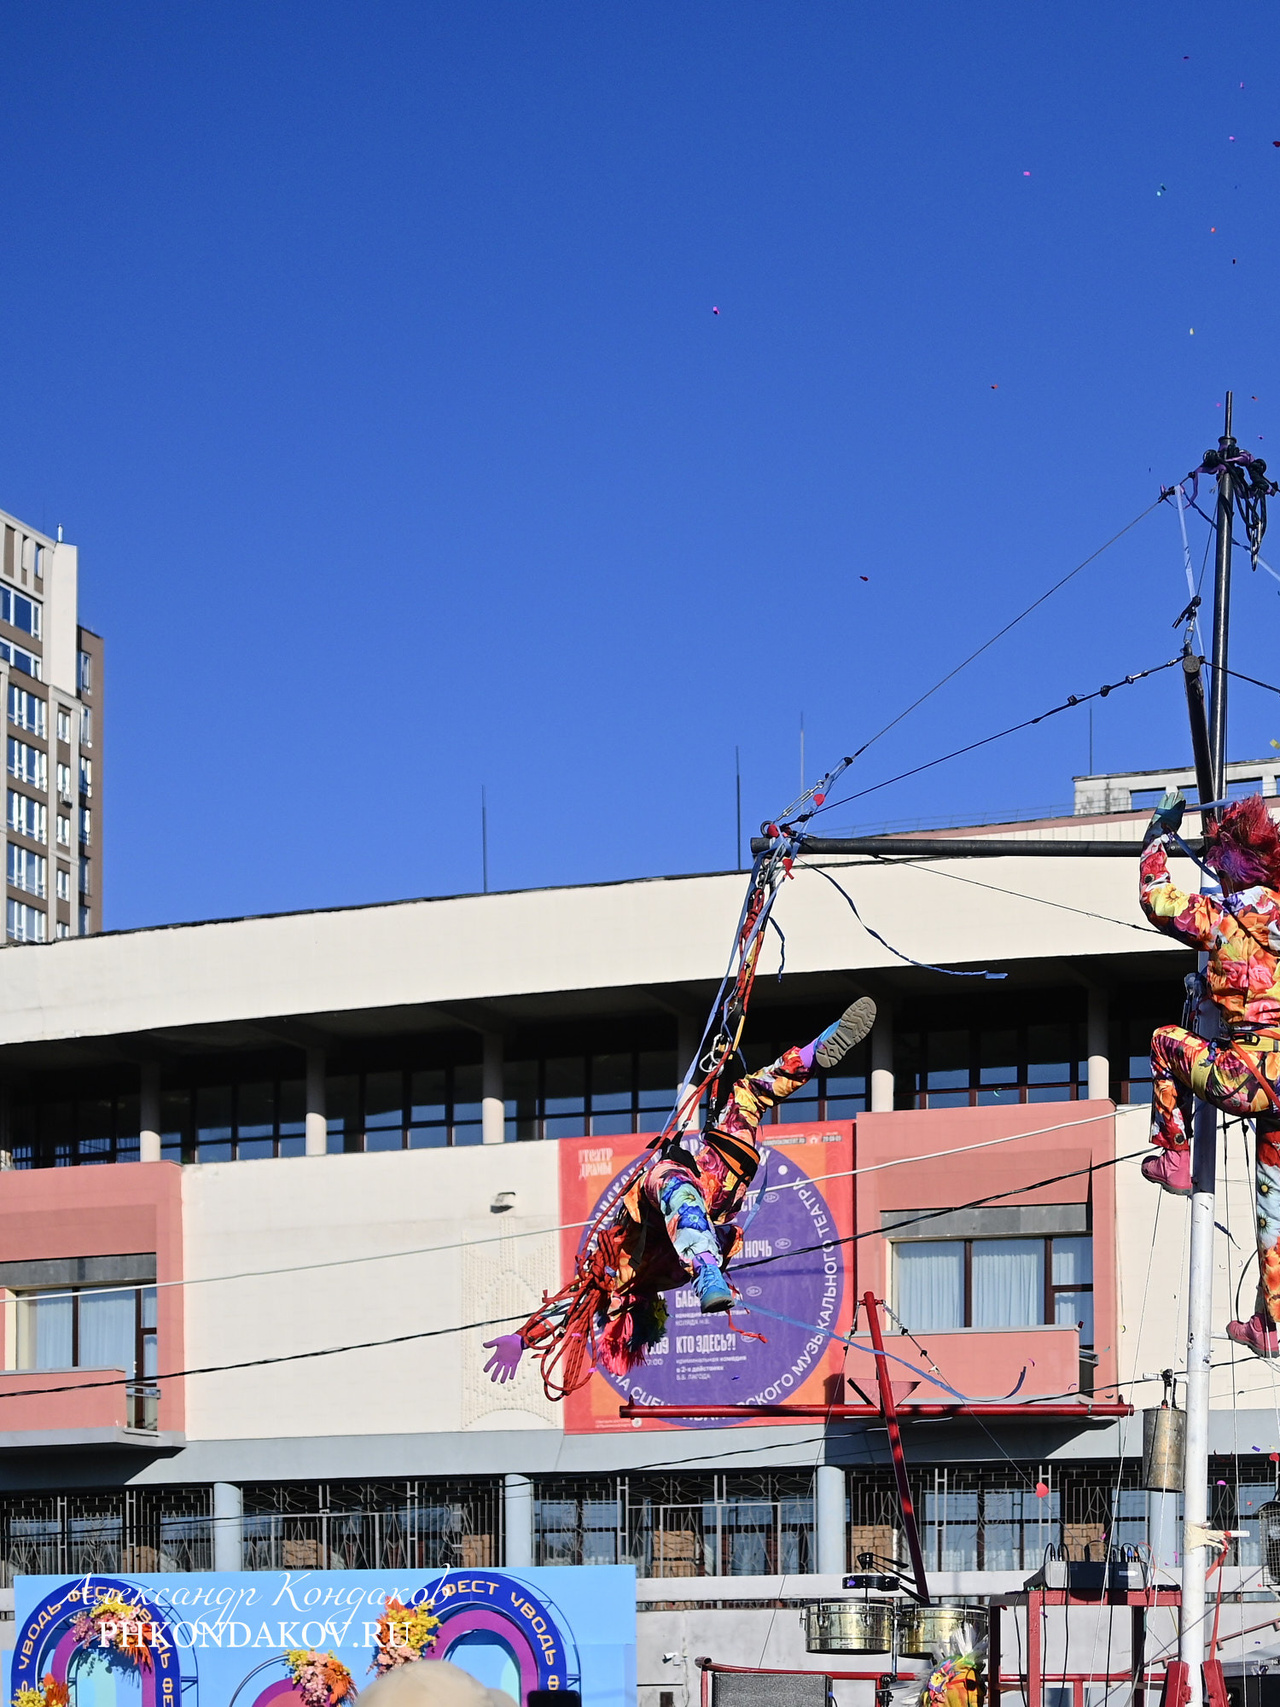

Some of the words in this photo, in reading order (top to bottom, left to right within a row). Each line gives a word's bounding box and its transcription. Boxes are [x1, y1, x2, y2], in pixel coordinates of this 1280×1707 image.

[744, 1239, 773, 1258] НОЧЬ
[791, 1238, 838, 1377] МУЗЫКАЛЬНОГО
[676, 1335, 695, 1354] КТО
[696, 1333, 737, 1354] ЗДЕСЬ?!
[610, 1371, 630, 1392] НА
[441, 1579, 500, 1597] ФЕСТ
[510, 1590, 558, 1666] УВОДЬ
